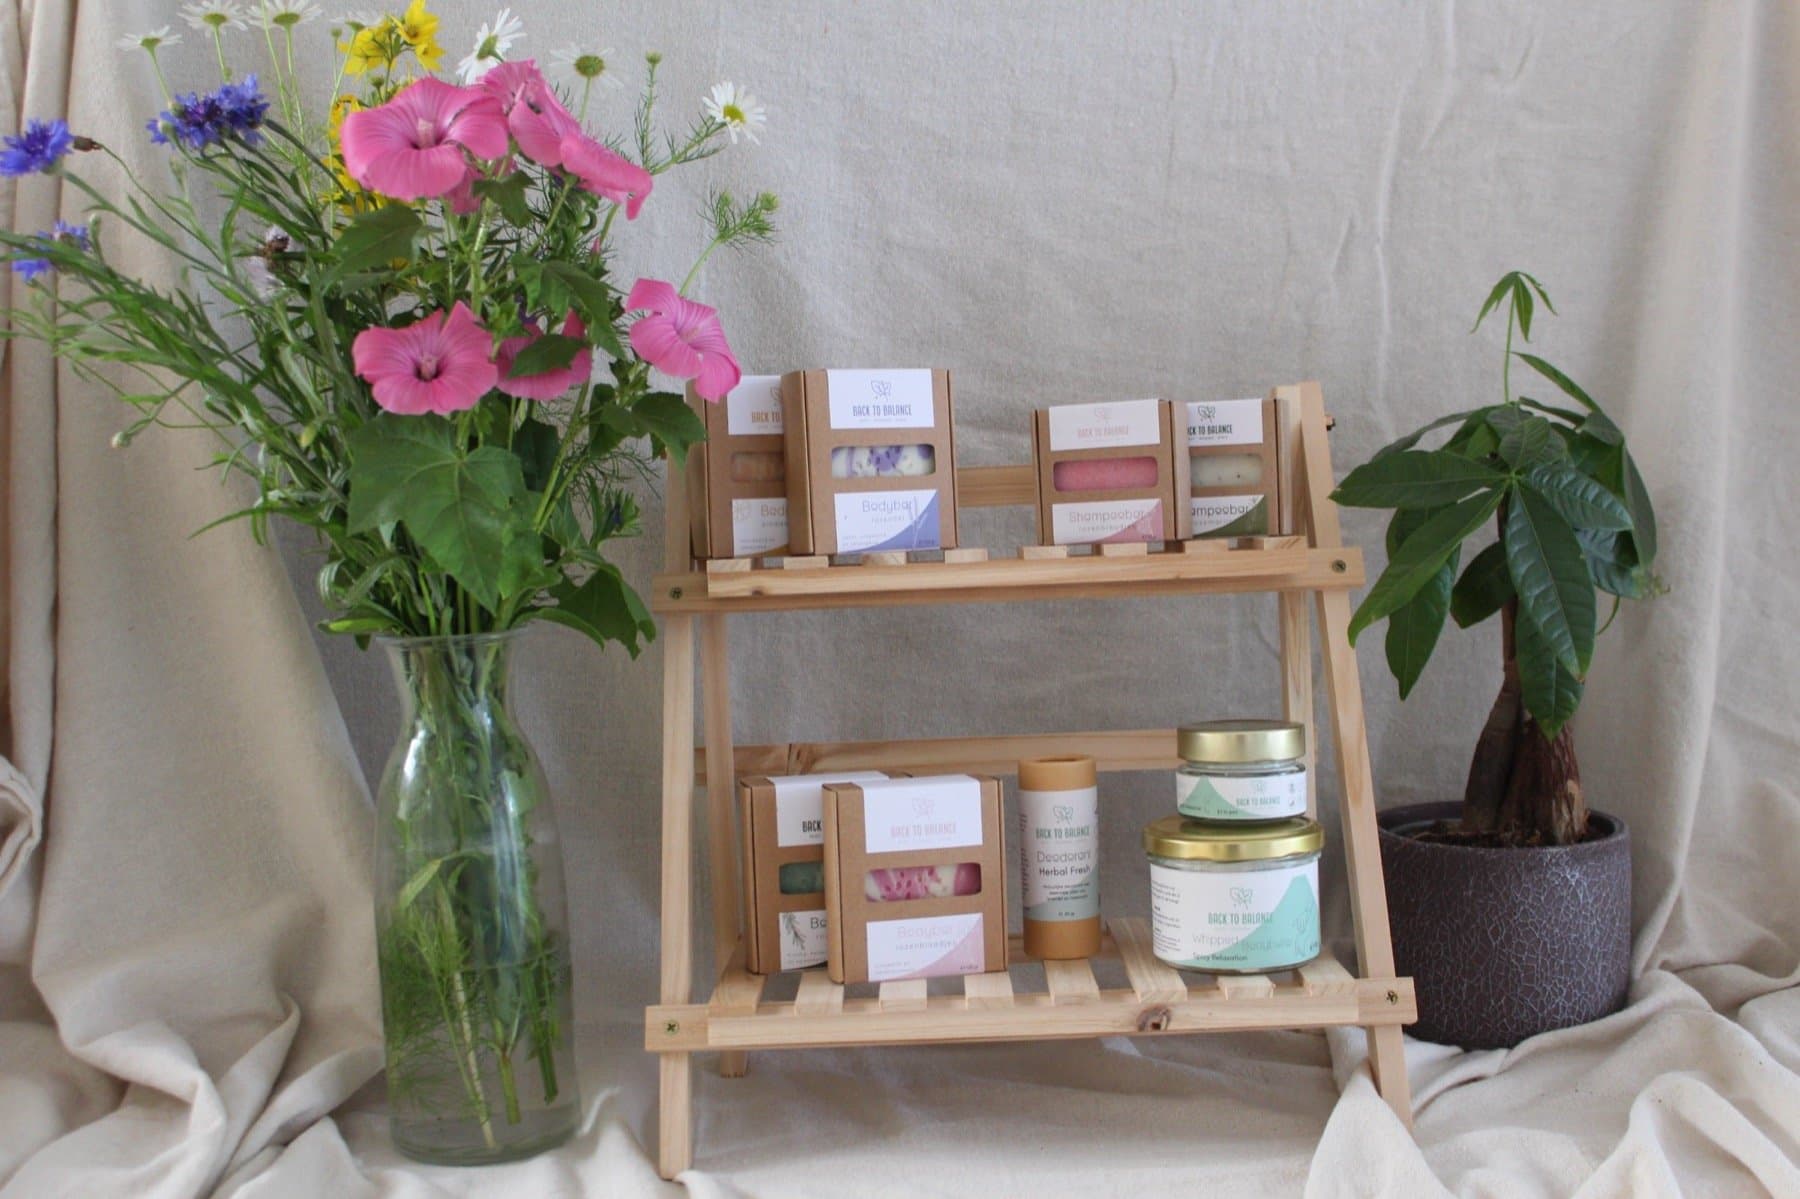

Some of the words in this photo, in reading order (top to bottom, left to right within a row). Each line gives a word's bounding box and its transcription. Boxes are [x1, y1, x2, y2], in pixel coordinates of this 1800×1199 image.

[751, 410, 769, 423] BACK
[852, 405, 870, 417] BACK
[872, 404, 882, 416] TO
[883, 404, 912, 416] BALANCE
[1077, 425, 1094, 438] BACK
[1104, 424, 1129, 436] BALANCE
[1198, 425, 1206, 436] TO
[1207, 424, 1233, 436] BALANCE
[861, 499, 913, 515] Bodybar
[1069, 509, 1146, 523] Shampoobar
[1236, 797, 1250, 807] BACK
[1251, 797, 1260, 806] TO
[802, 820, 823, 833] BACK
[891, 824, 911, 838] BACK
[912, 824, 923, 837] TO
[924, 822, 957, 835] BALANCE
[1036, 828, 1052, 839] BACK
[1054, 828, 1063, 839] TO
[1064, 825, 1090, 838] BALANCE
[1039, 866, 1068, 877] Herbal
[1071, 864, 1091, 875] Fresh
[1208, 912, 1227, 925] BACK
[1230, 912, 1240, 925] TO
[1241, 911, 1274, 925] BALANCE
